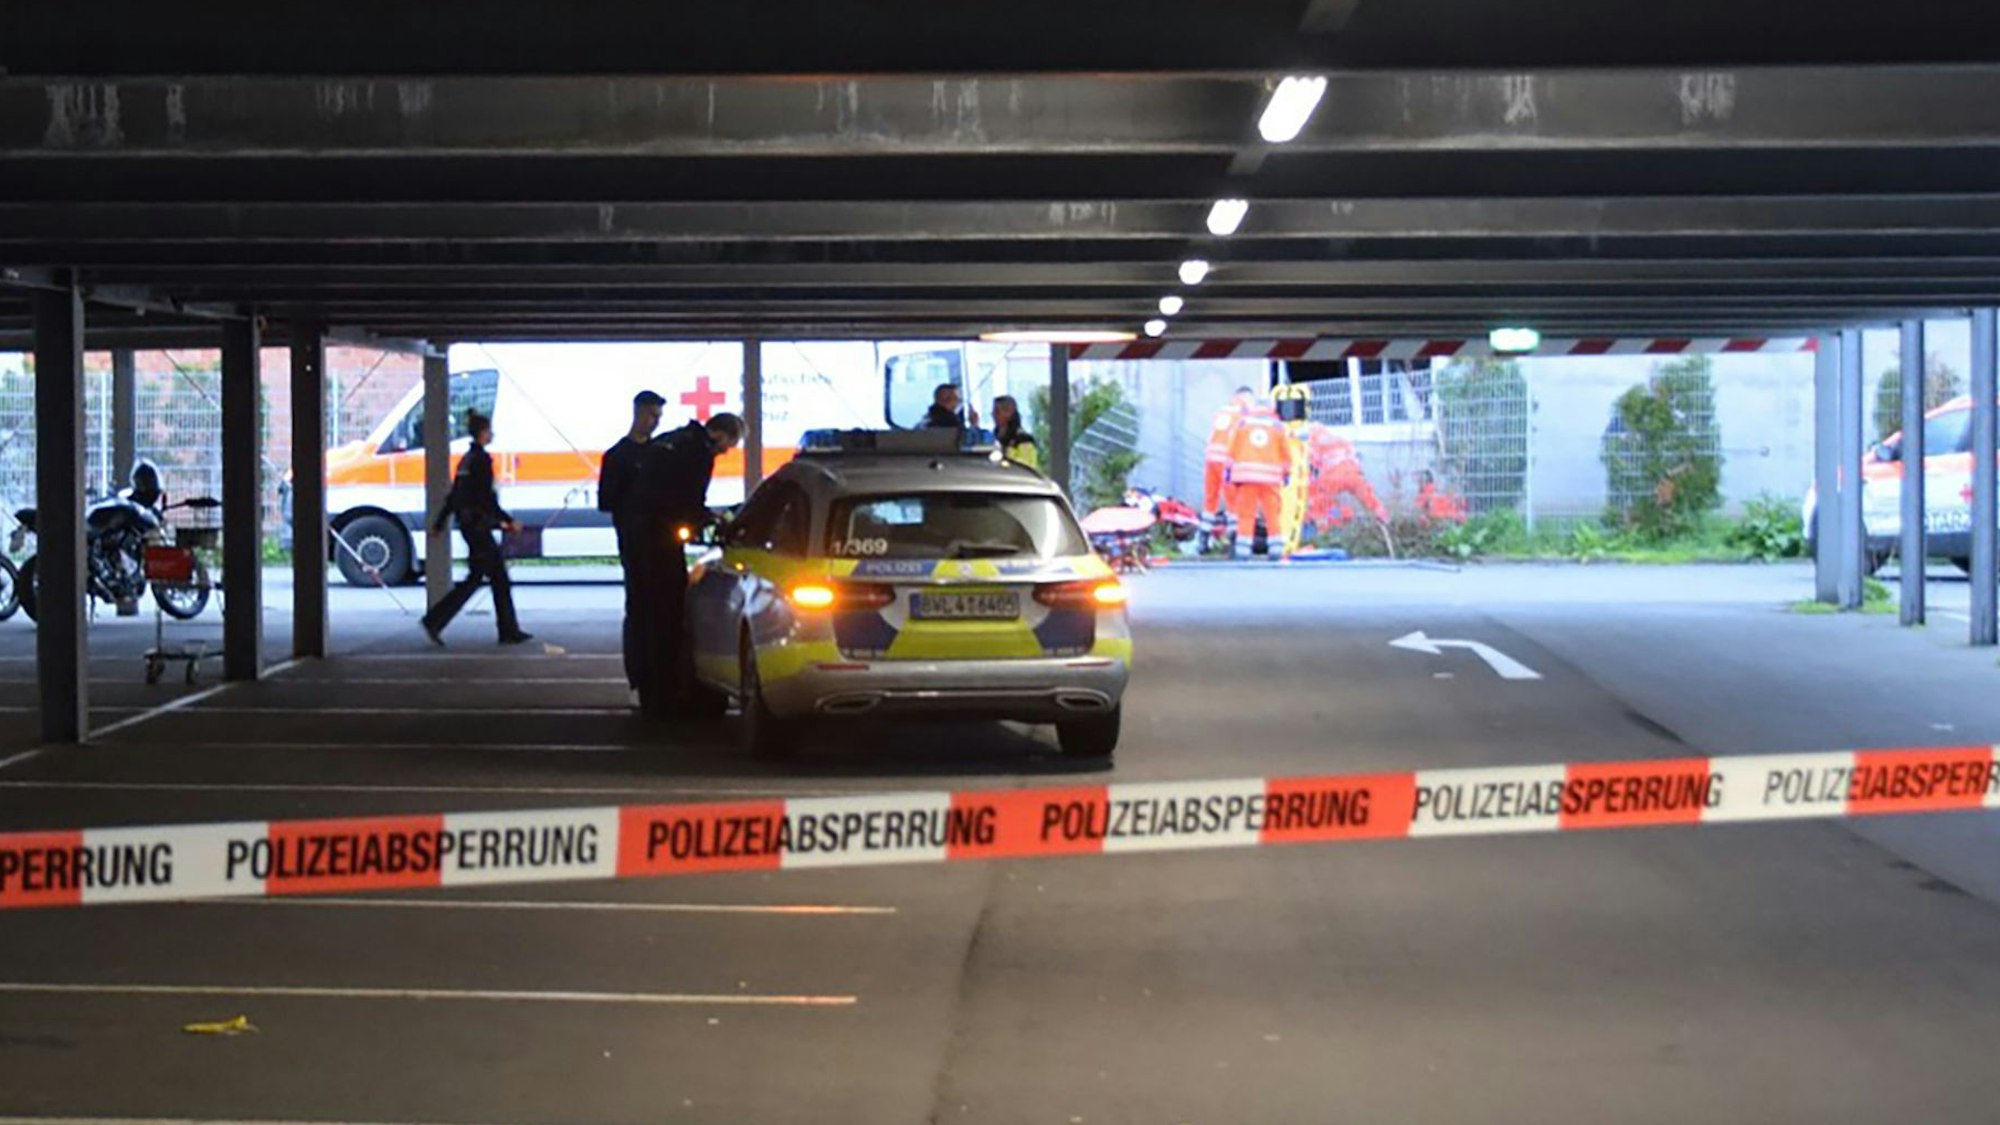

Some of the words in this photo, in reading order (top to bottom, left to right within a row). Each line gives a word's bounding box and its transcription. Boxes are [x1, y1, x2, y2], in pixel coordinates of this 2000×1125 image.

[832, 538, 888, 555] 1/369
[866, 562, 922, 575] POLIZEI
[1041, 789, 1370, 841] POLIZEIABSPERRUNG
[1414, 773, 1724, 821] POLIZEIABSPERRUNG
[225, 824, 599, 881] POLIZEIABSPERRUNG
[647, 806, 997, 861] POLIZEIABSPERRUNG
